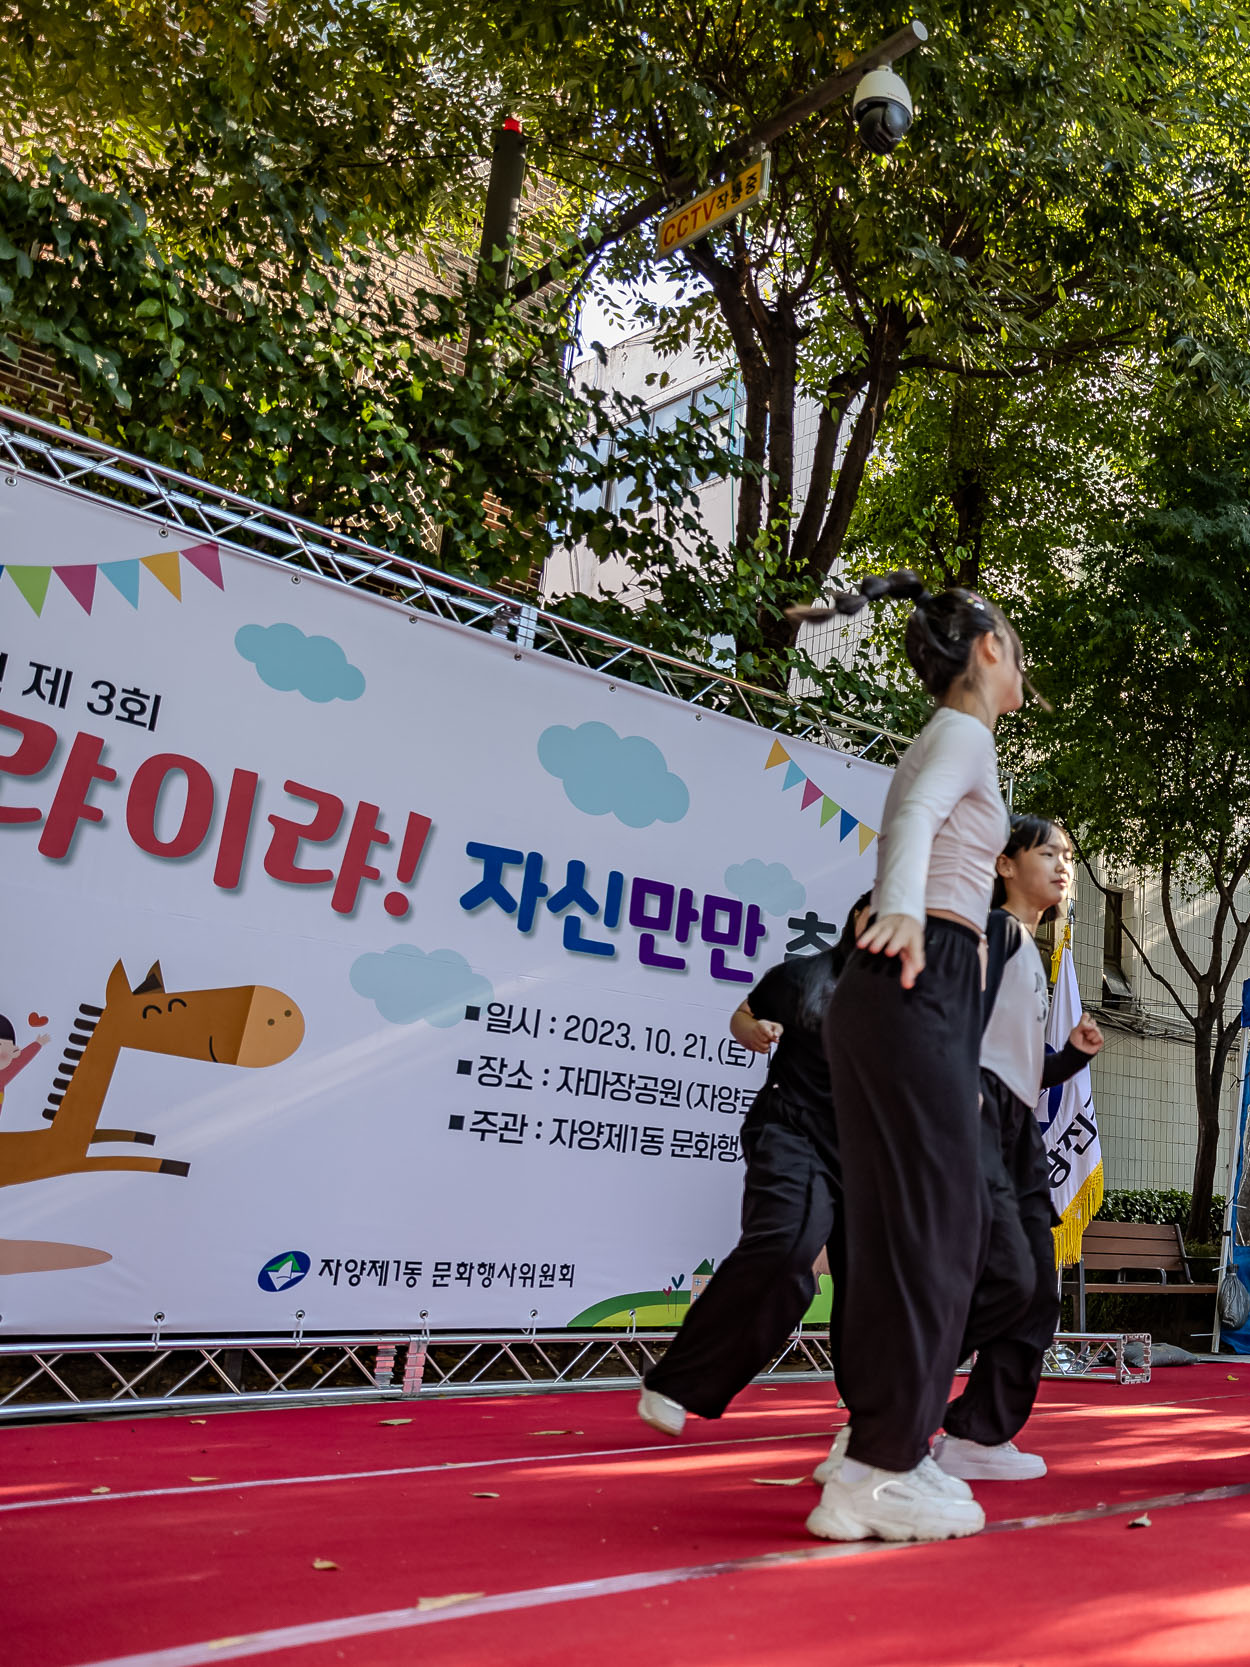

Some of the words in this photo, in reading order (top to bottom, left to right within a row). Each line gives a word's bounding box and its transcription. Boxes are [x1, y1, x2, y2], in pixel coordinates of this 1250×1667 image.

[22, 661, 73, 709] 제
[86, 680, 162, 732] 3회
[459, 841, 766, 983] 자신만만
[486, 1002, 541, 1038] 일시
[563, 1014, 636, 1051] 2023.
[645, 1027, 677, 1057] 10.
[477, 1055, 533, 1090] 장소
[469, 1110, 528, 1144] 주관
[549, 1117, 664, 1156] 자양제1동
[670, 1129, 744, 1163] 문화행
[318, 1258, 423, 1288] 자양제1동
[431, 1261, 576, 1289] 문화행사위원회
